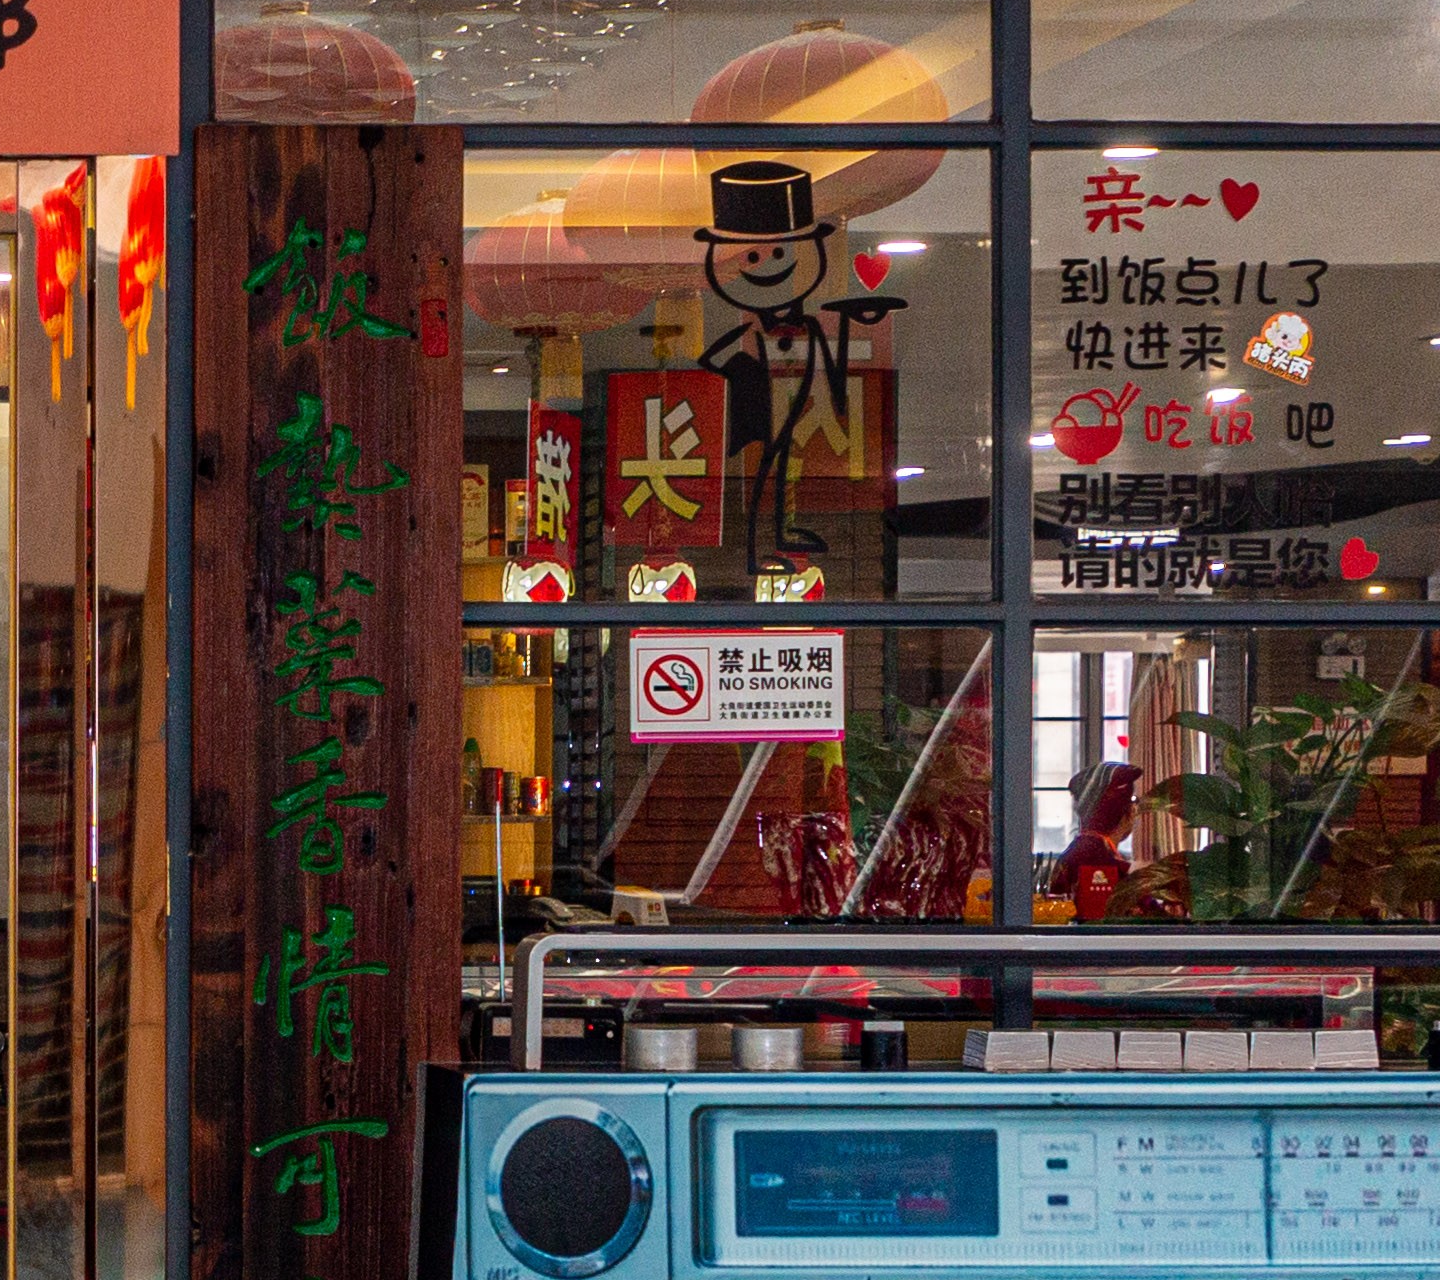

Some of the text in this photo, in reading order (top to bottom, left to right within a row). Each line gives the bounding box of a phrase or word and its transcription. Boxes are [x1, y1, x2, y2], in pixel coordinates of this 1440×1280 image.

[1059, 257, 1330, 308] 到饭点儿了
[1066, 321, 1227, 372] 快进来
[1144, 395, 1335, 449] 吃饭 吧
[1060, 538, 1332, 590] 请的就是您
[719, 647, 832, 673] 禁止吸烟
[719, 677, 833, 690] NO SMOKING
